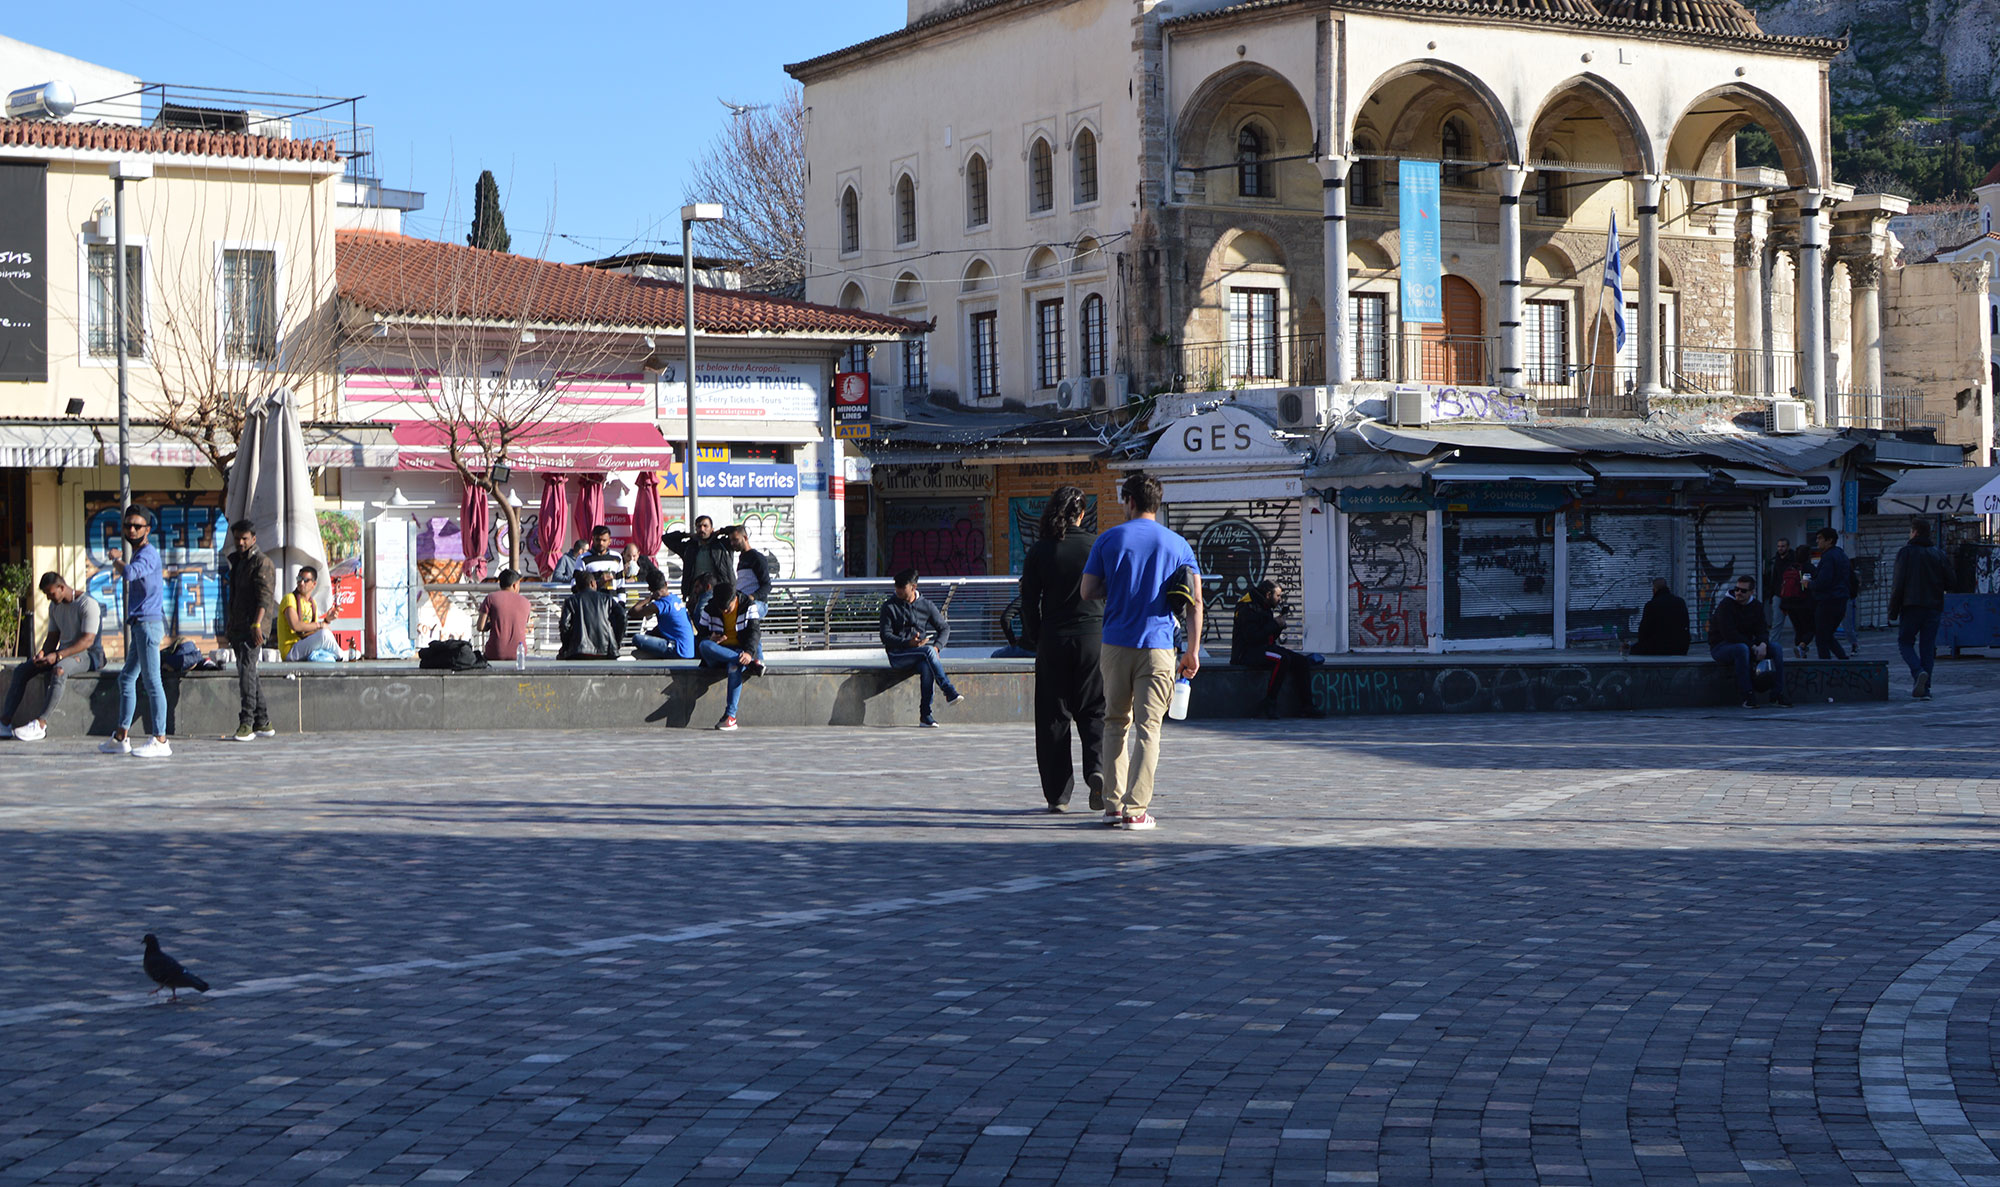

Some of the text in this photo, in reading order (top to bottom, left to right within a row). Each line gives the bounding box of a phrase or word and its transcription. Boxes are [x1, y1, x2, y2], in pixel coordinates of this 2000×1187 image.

[706, 362, 729, 372] below
[731, 363, 744, 372] the
[757, 377, 803, 390] TRAVEL
[664, 395, 675, 403] Air
[708, 396, 728, 405] Ferry
[730, 396, 756, 404] Tickets
[837, 405, 868, 413] MINOAN
[839, 426, 868, 436] ATM
[1183, 424, 1251, 452] GES
[697, 447, 724, 458] ATM
[627, 458, 660, 467] waffles
[1019, 463, 1058, 476] MATER
[685, 471, 715, 488] ue
[718, 471, 746, 488] Star
[748, 471, 794, 488] Ferries
[887, 473, 988, 489] in the old mosque
[1348, 495, 1374, 504] GREEK
